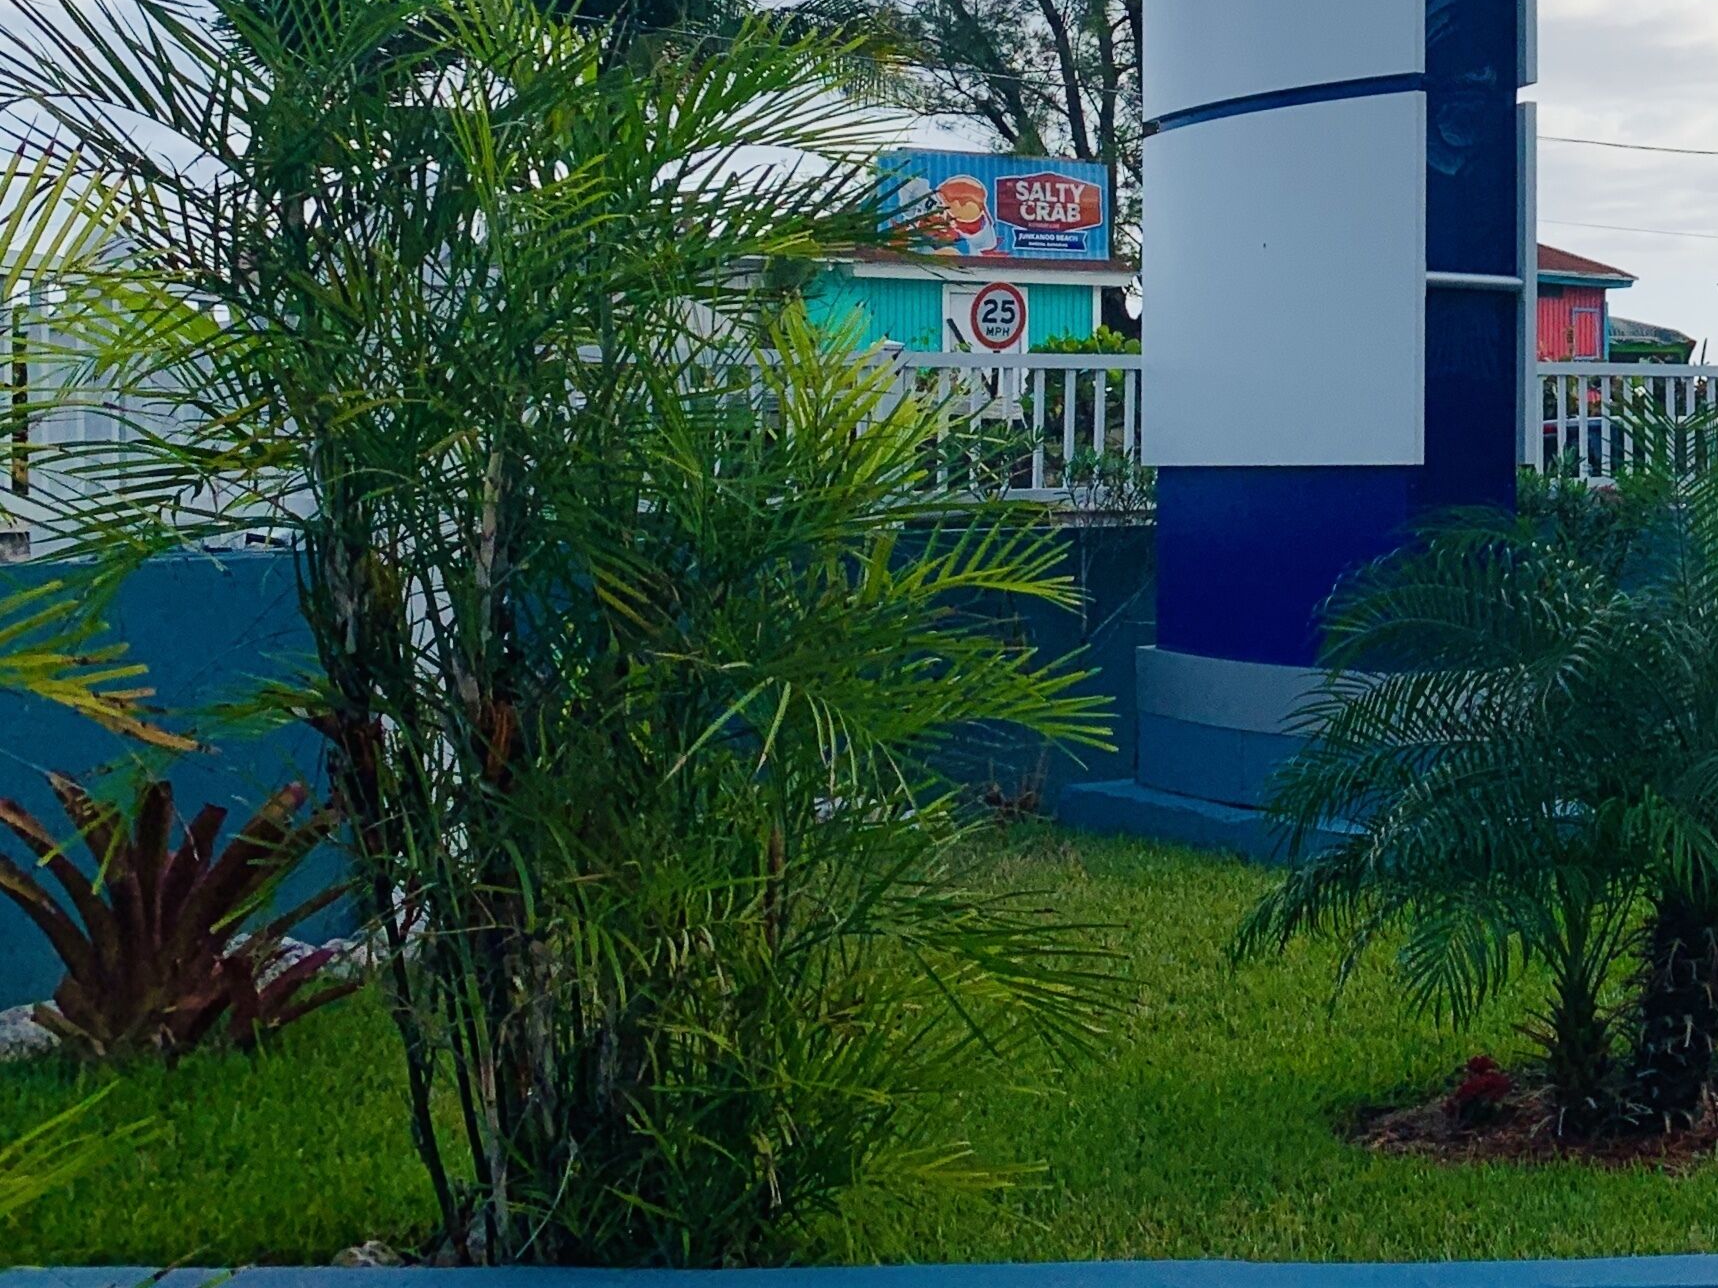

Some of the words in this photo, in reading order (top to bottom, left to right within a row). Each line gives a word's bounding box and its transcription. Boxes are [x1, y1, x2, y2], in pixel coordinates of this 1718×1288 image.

[1015, 180, 1086, 204] SALTY
[1020, 201, 1081, 223] CRAB
[1056, 234, 1079, 242] BEACH
[982, 299, 1016, 324] 25
[986, 326, 1010, 337] MPH
